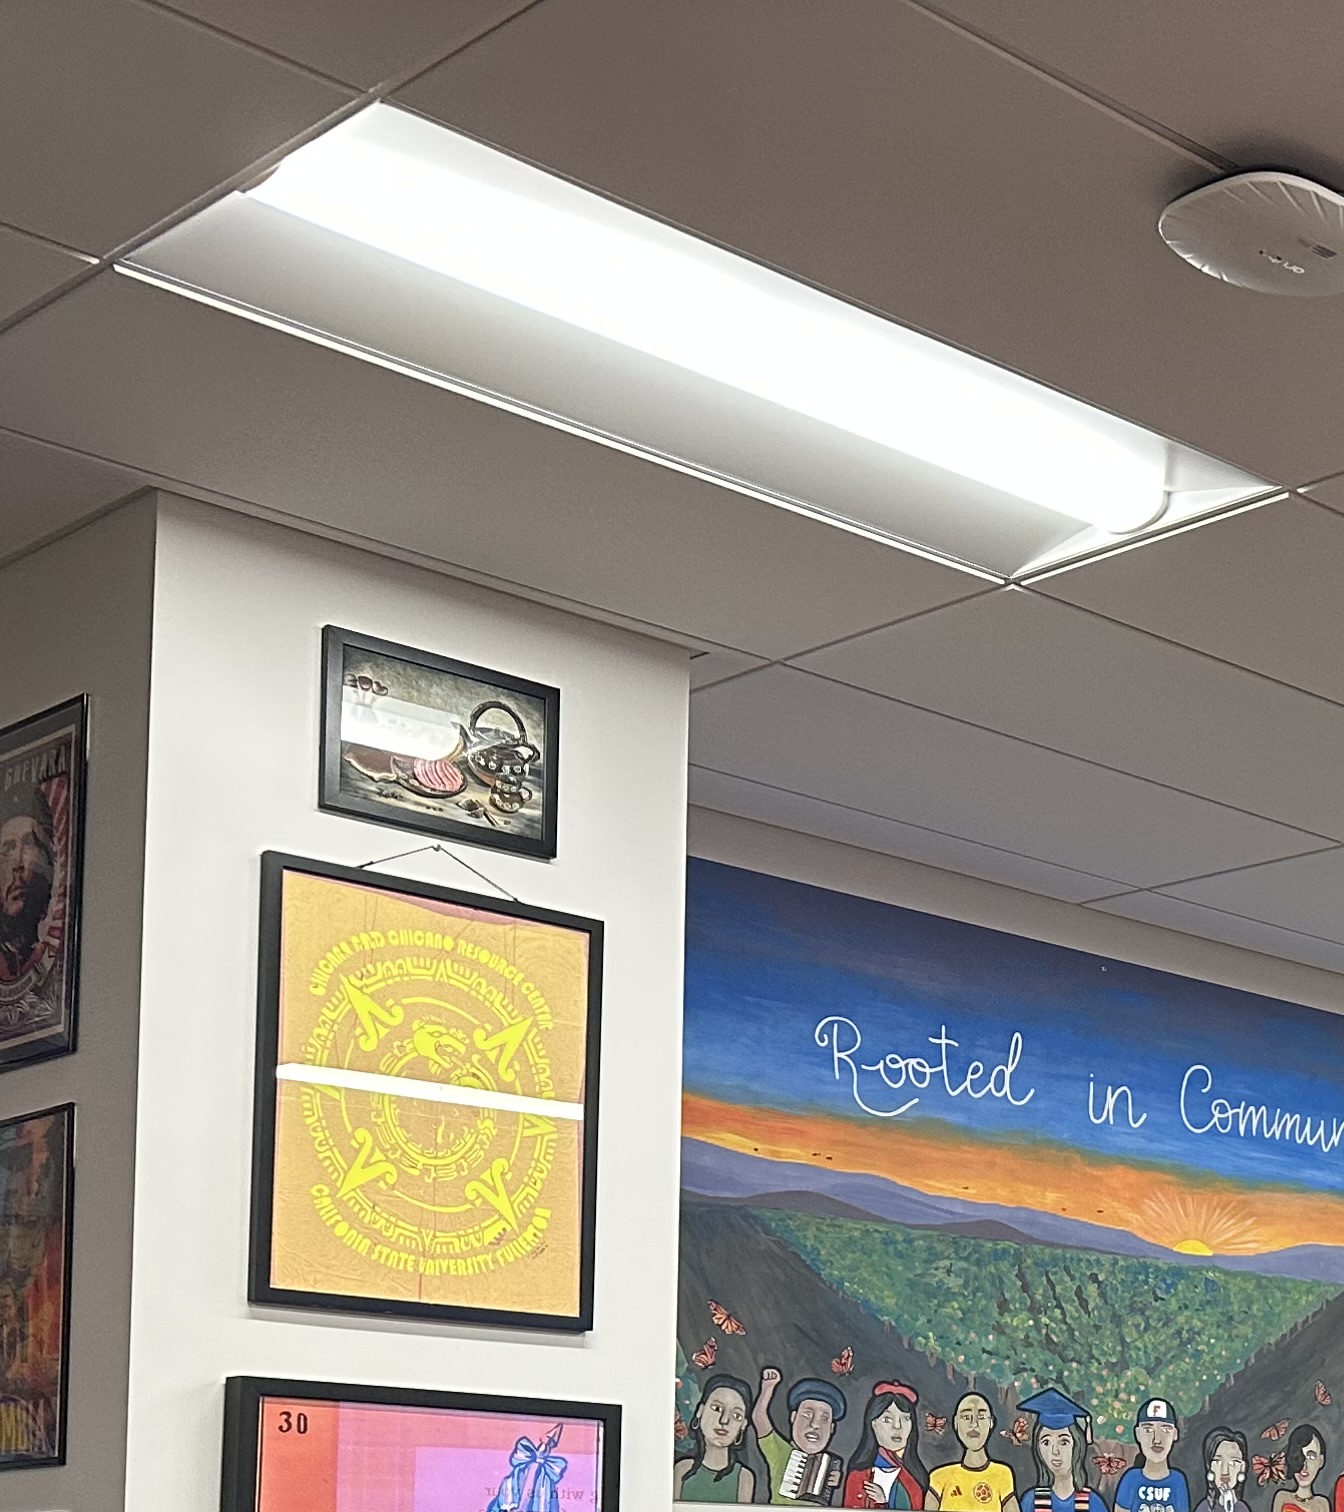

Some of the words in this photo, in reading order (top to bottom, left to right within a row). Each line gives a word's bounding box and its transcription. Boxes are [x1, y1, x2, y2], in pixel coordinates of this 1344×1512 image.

[387, 929, 455, 951] CHICANO
[457, 939, 524, 986] RESOURCE
[521, 981, 553, 1030] CENTER
[815, 1015, 1034, 1118] Rooted
[1086, 1072, 1148, 1130] in
[370, 1244, 415, 1273] STATE
[418, 1252, 495, 1276] UNIVERSITY
[277, 1411, 309, 1436] 30
[1152, 1405, 1161, 1417] F
[1138, 1486, 1171, 1501] CSUF
